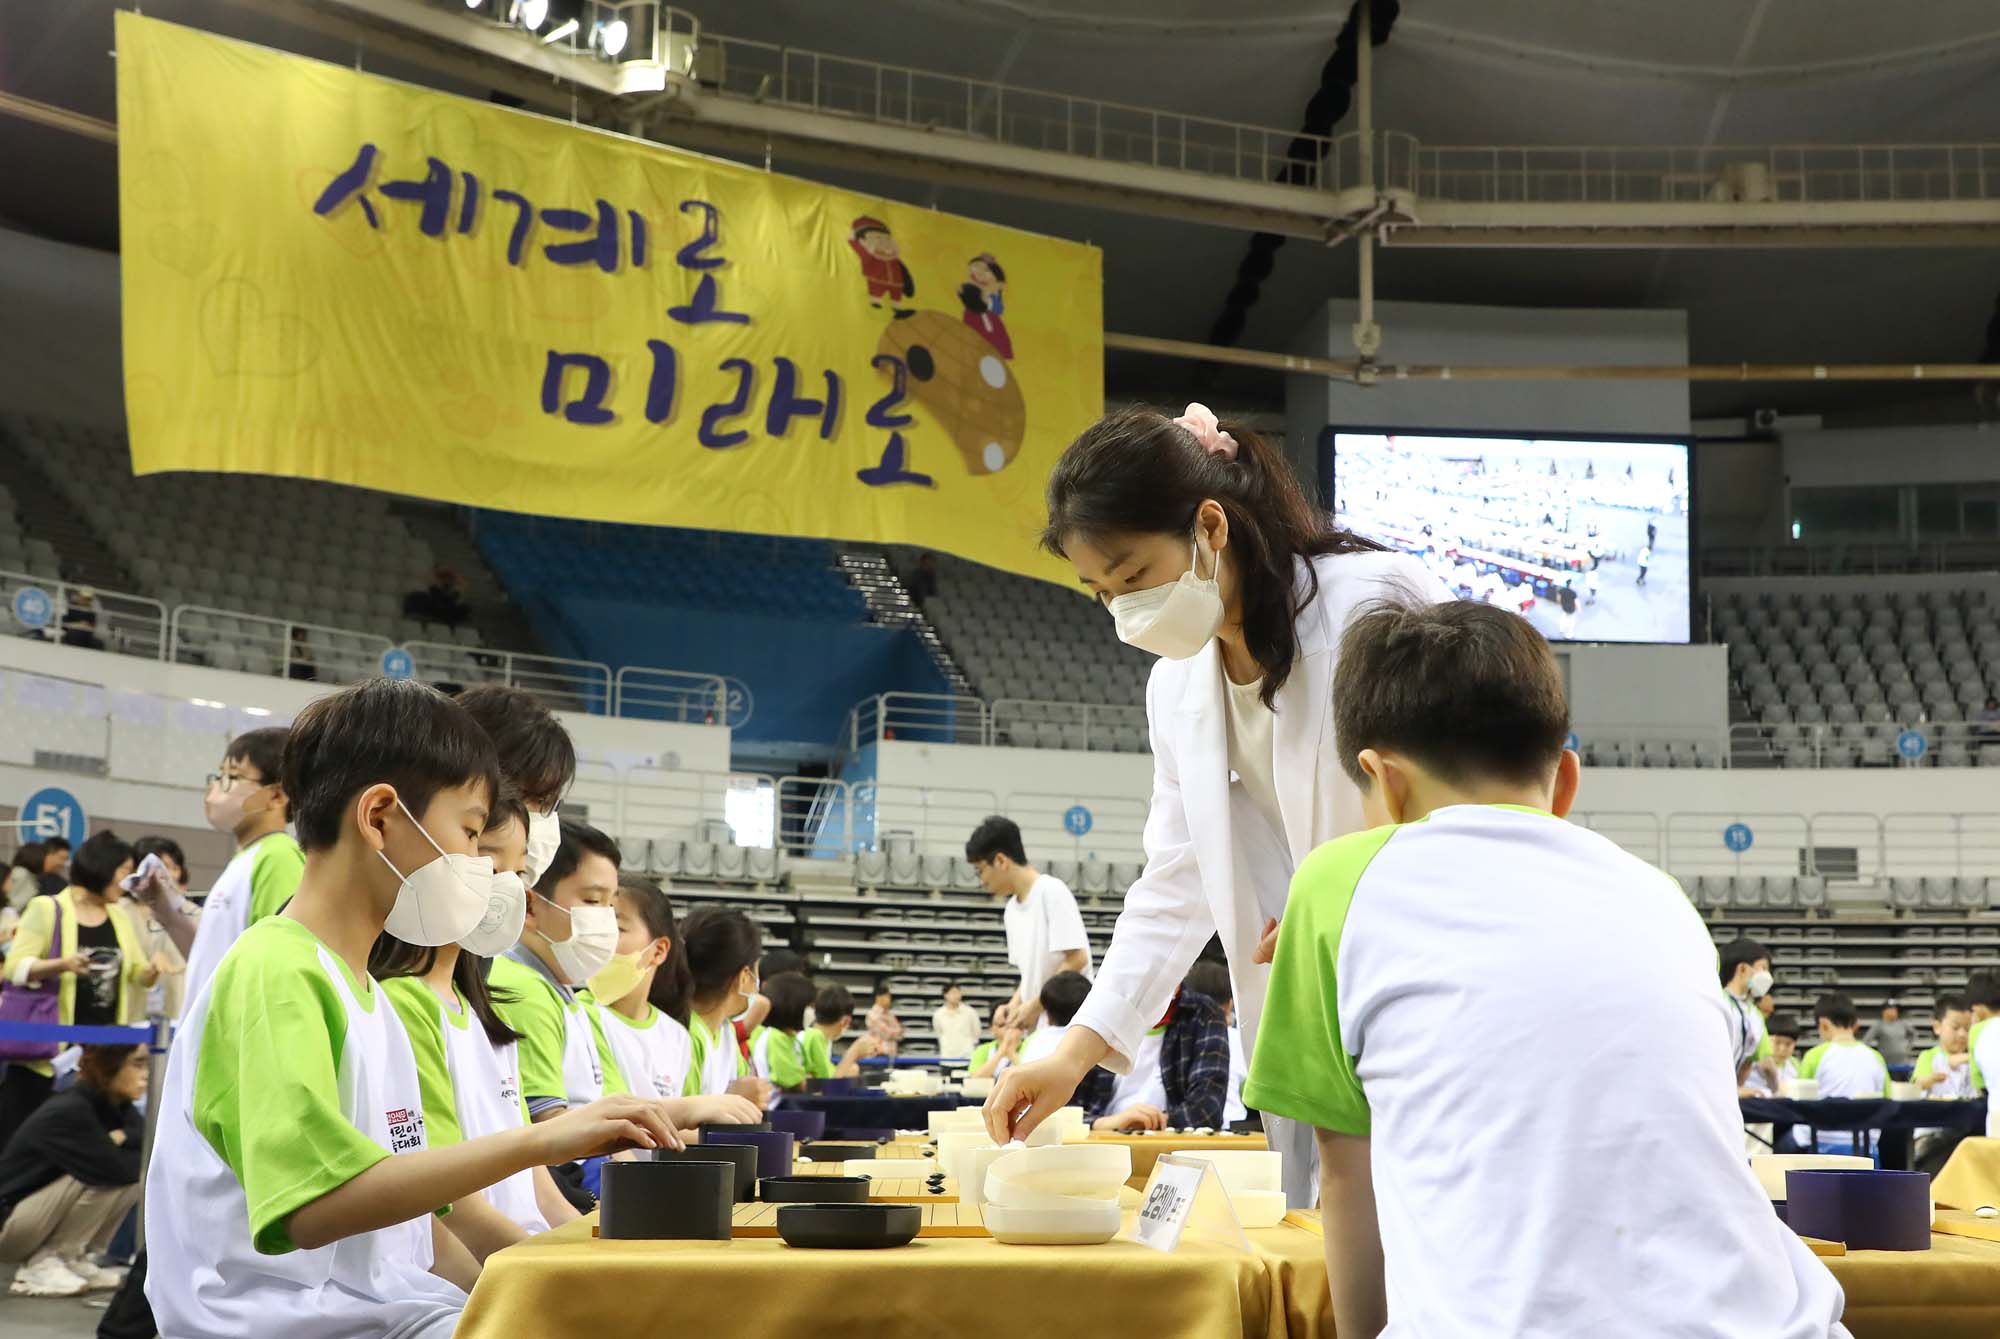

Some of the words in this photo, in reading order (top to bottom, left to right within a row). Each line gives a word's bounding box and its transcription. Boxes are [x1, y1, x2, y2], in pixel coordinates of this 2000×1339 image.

[314, 144, 752, 325] 세계로
[541, 339, 934, 488] 미래로
[36, 803, 71, 838] 51
